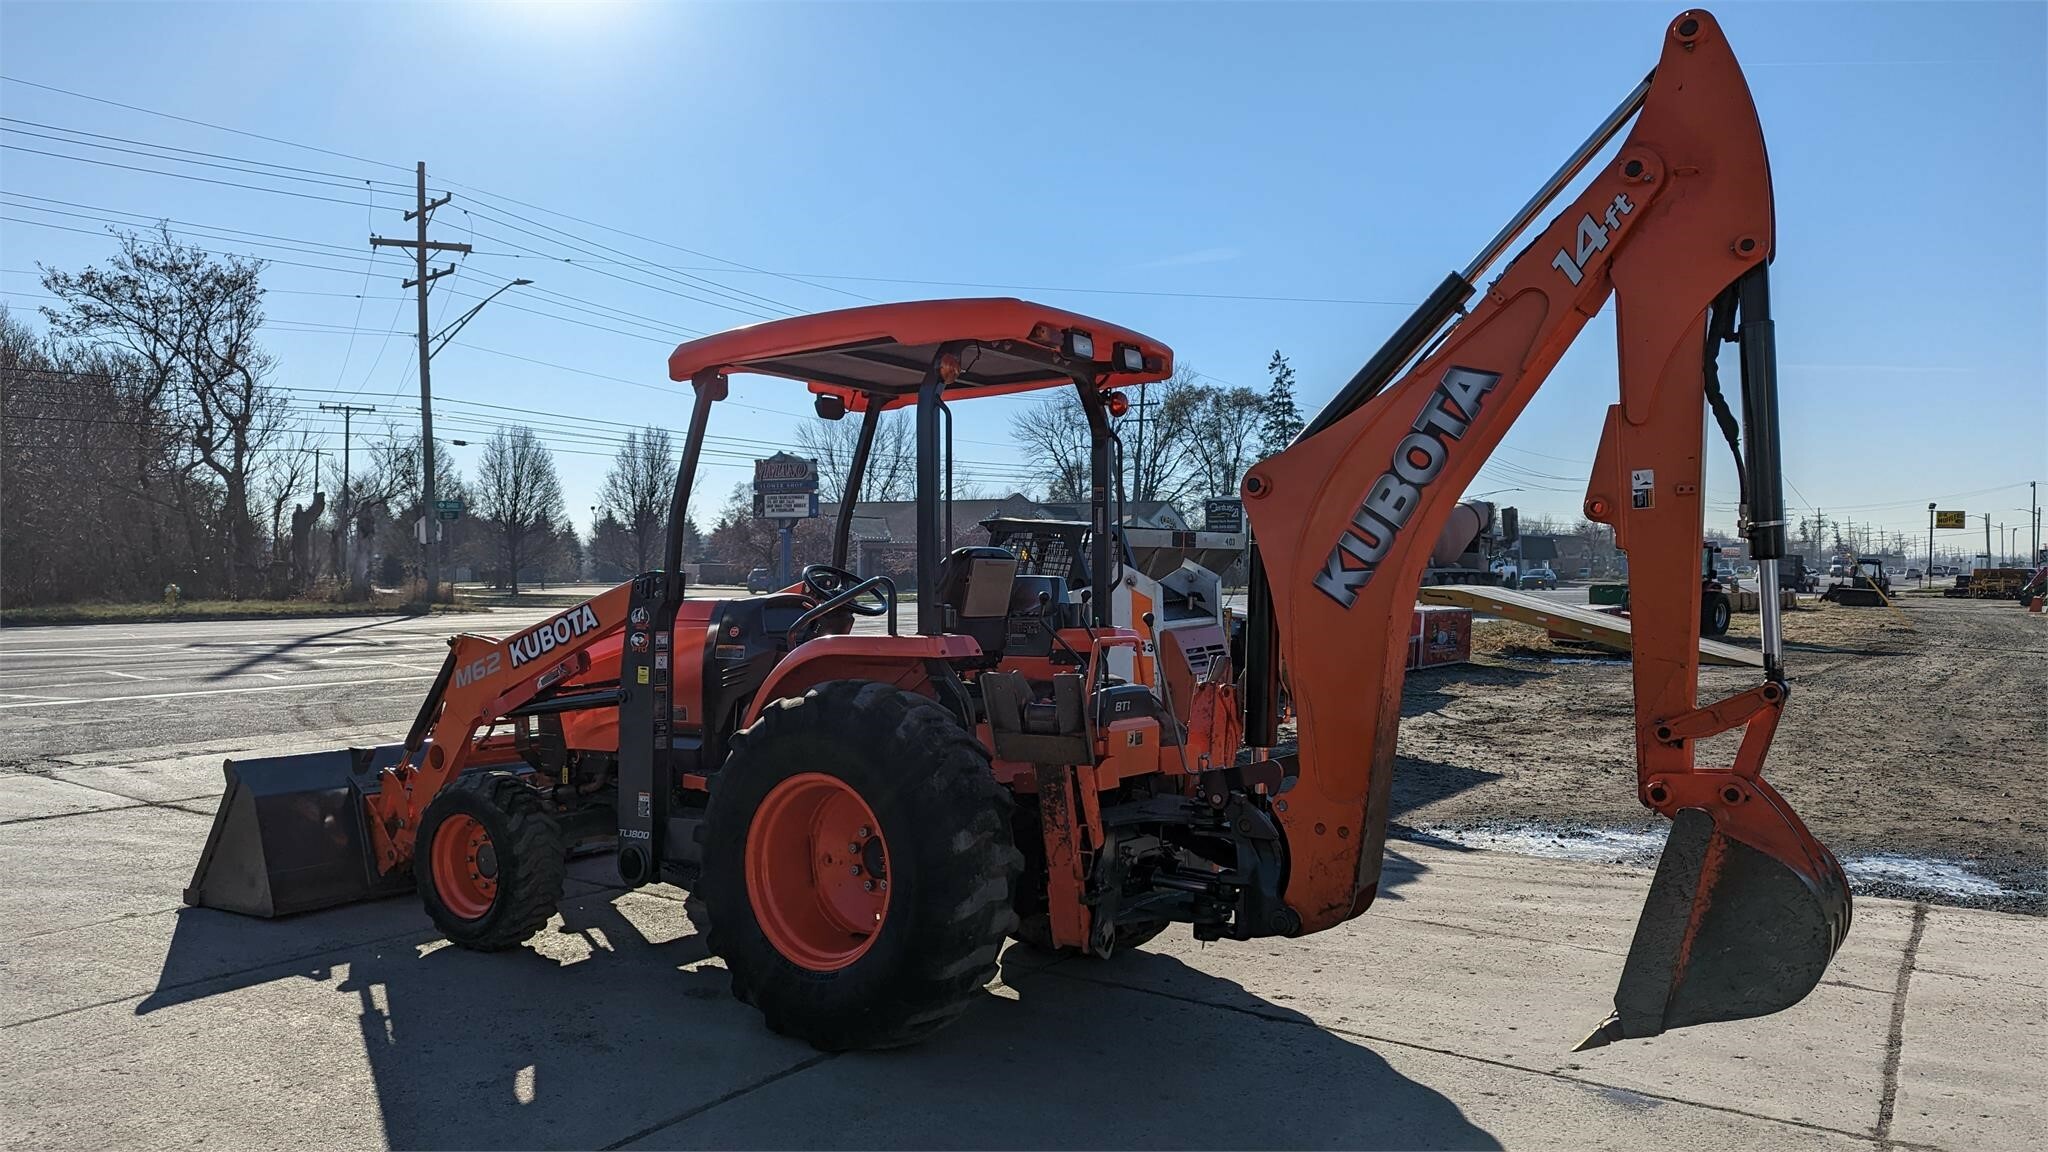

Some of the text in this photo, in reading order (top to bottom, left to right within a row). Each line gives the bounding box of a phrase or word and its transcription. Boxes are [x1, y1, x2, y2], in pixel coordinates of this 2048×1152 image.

[1312, 366, 1502, 610] KUBOTA
[508, 604, 599, 668] KUBOTA
[455, 652, 500, 688] M62
